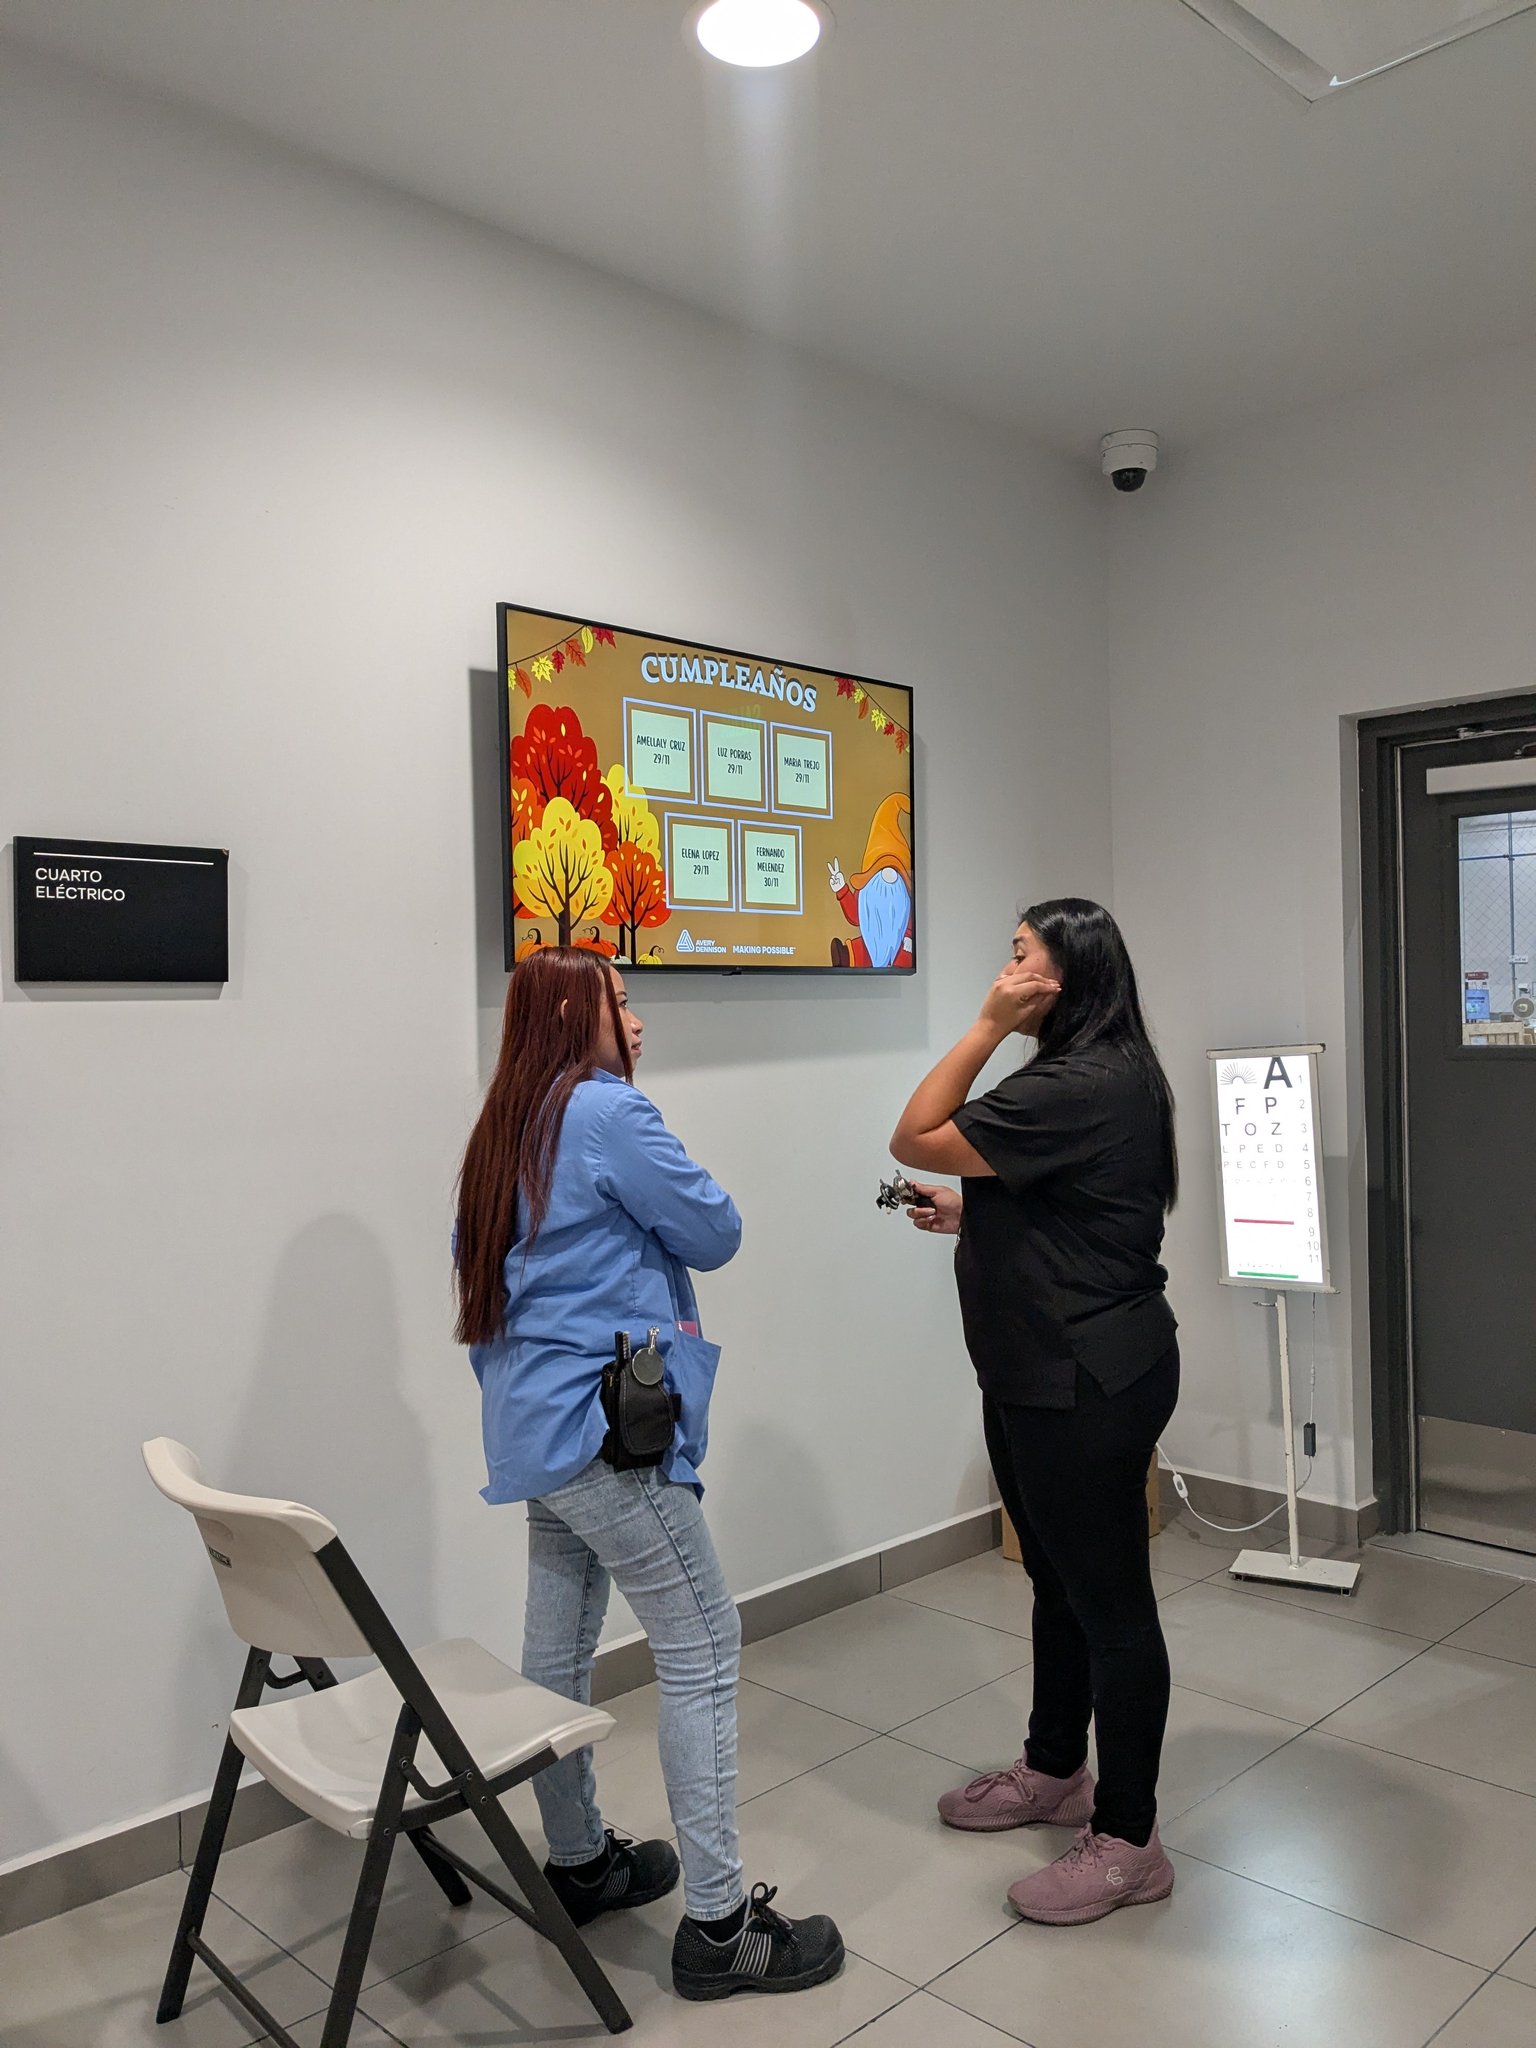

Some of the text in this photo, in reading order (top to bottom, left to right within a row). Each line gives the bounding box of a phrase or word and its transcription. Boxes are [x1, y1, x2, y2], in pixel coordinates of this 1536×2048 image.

[641, 653, 817, 712] CUMPLEAÑOS
[636, 734, 686, 752] AMELLALY CRUZ
[653, 753, 670, 765] 29/11
[717, 747, 752, 761] LUZ PORRAS
[727, 763, 743, 775] 29/11
[784, 756, 820, 771] MARIA TREJO
[795, 772, 810, 784] 29/11
[681, 848, 720, 861] ELENA LOPEZ
[756, 846, 785, 859] FERNANDO
[693, 864, 709, 876] 29/11
[757, 862, 785, 874] MELENDEZ
[35, 867, 103, 884] CUARTO
[764, 877, 779, 888] 30/11
[35, 884, 126, 902] ELÉCTRICO
[695, 939, 716, 947] AVERY
[695, 945, 727, 954] DENNISON
[732, 945, 762, 954] MAKING
[1263, 1056, 1293, 1090] A
[1235, 1098, 1246, 1115] F
[1264, 1096, 1278, 1114] P
[1221, 1123, 1231, 1137] T
[1244, 1122, 1257, 1136] O
[1271, 1122, 1283, 1136] Z
